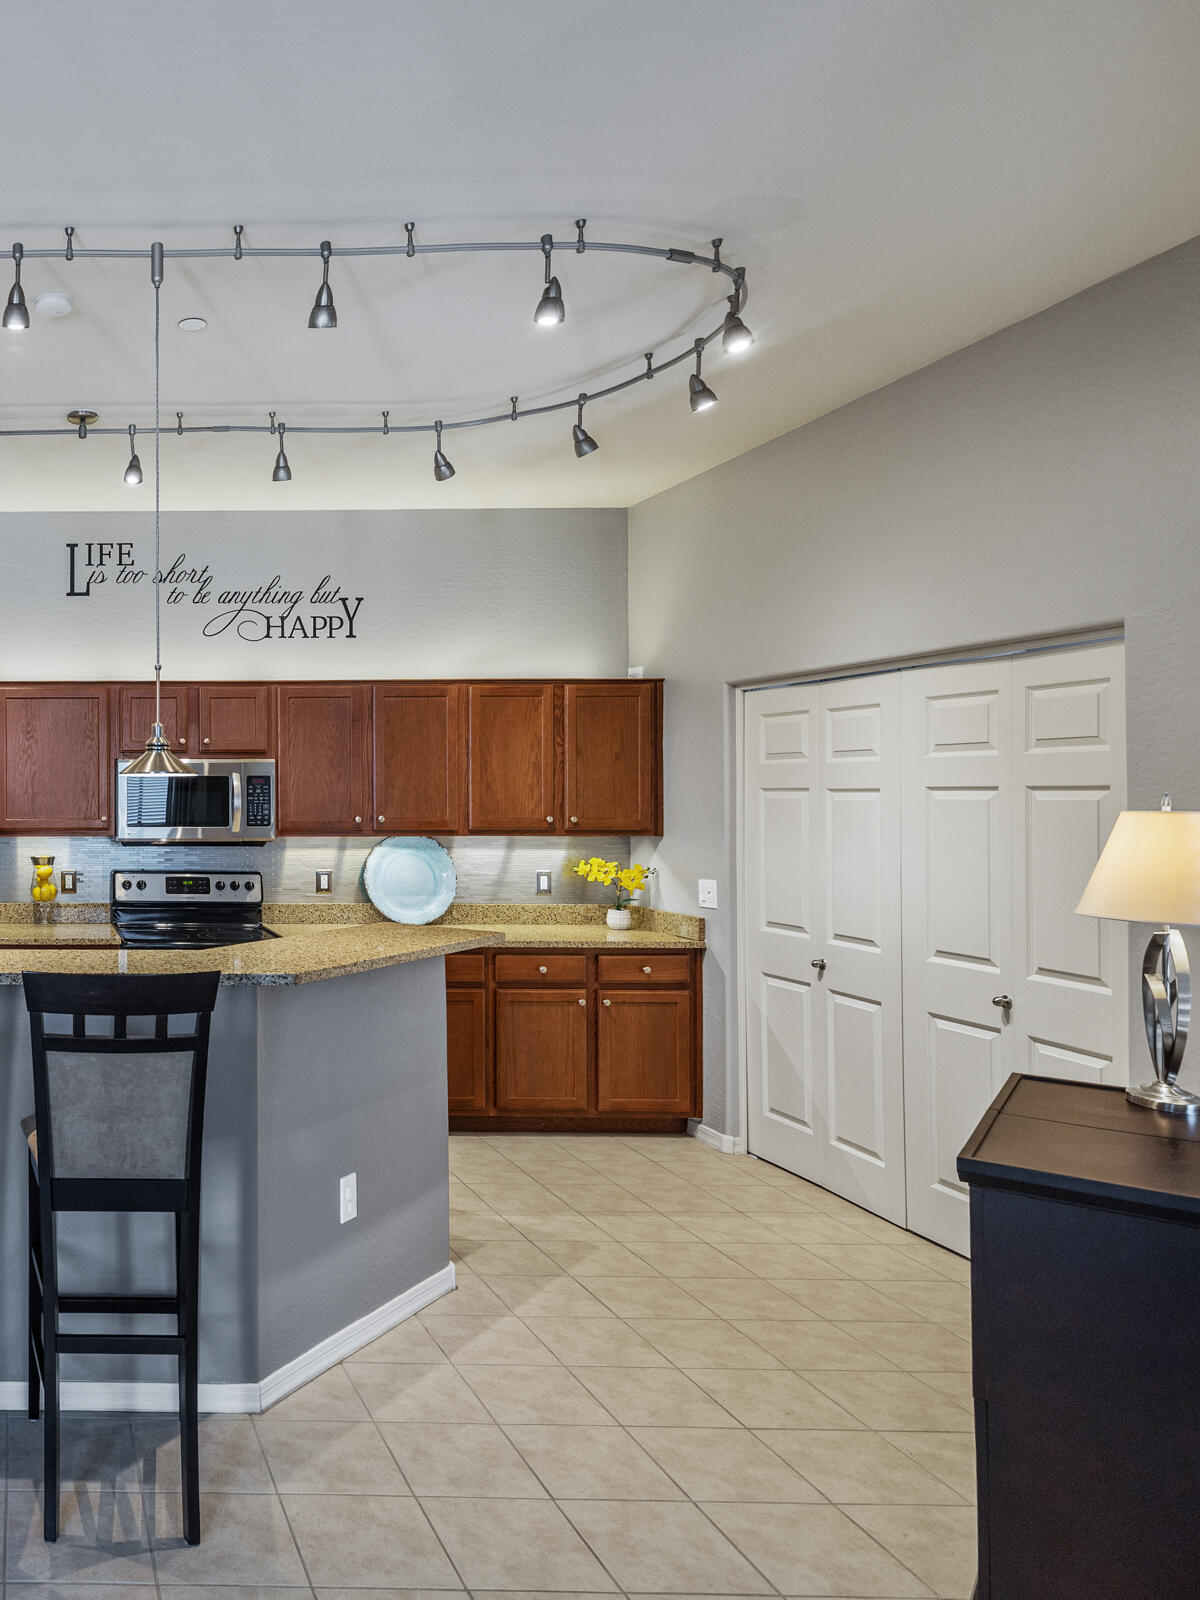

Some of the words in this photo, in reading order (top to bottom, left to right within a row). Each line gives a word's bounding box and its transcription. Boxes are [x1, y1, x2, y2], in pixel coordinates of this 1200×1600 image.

[65, 542, 135, 597] LIFE
[87, 565, 108, 584] is
[116, 565, 149, 584] too
[152, 553, 209, 584] short
[166, 586, 189, 605] to
[192, 575, 213, 605] be
[203, 574, 304, 637] anything
[309, 574, 341, 604] but
[264, 597, 364, 639] HAPPY
